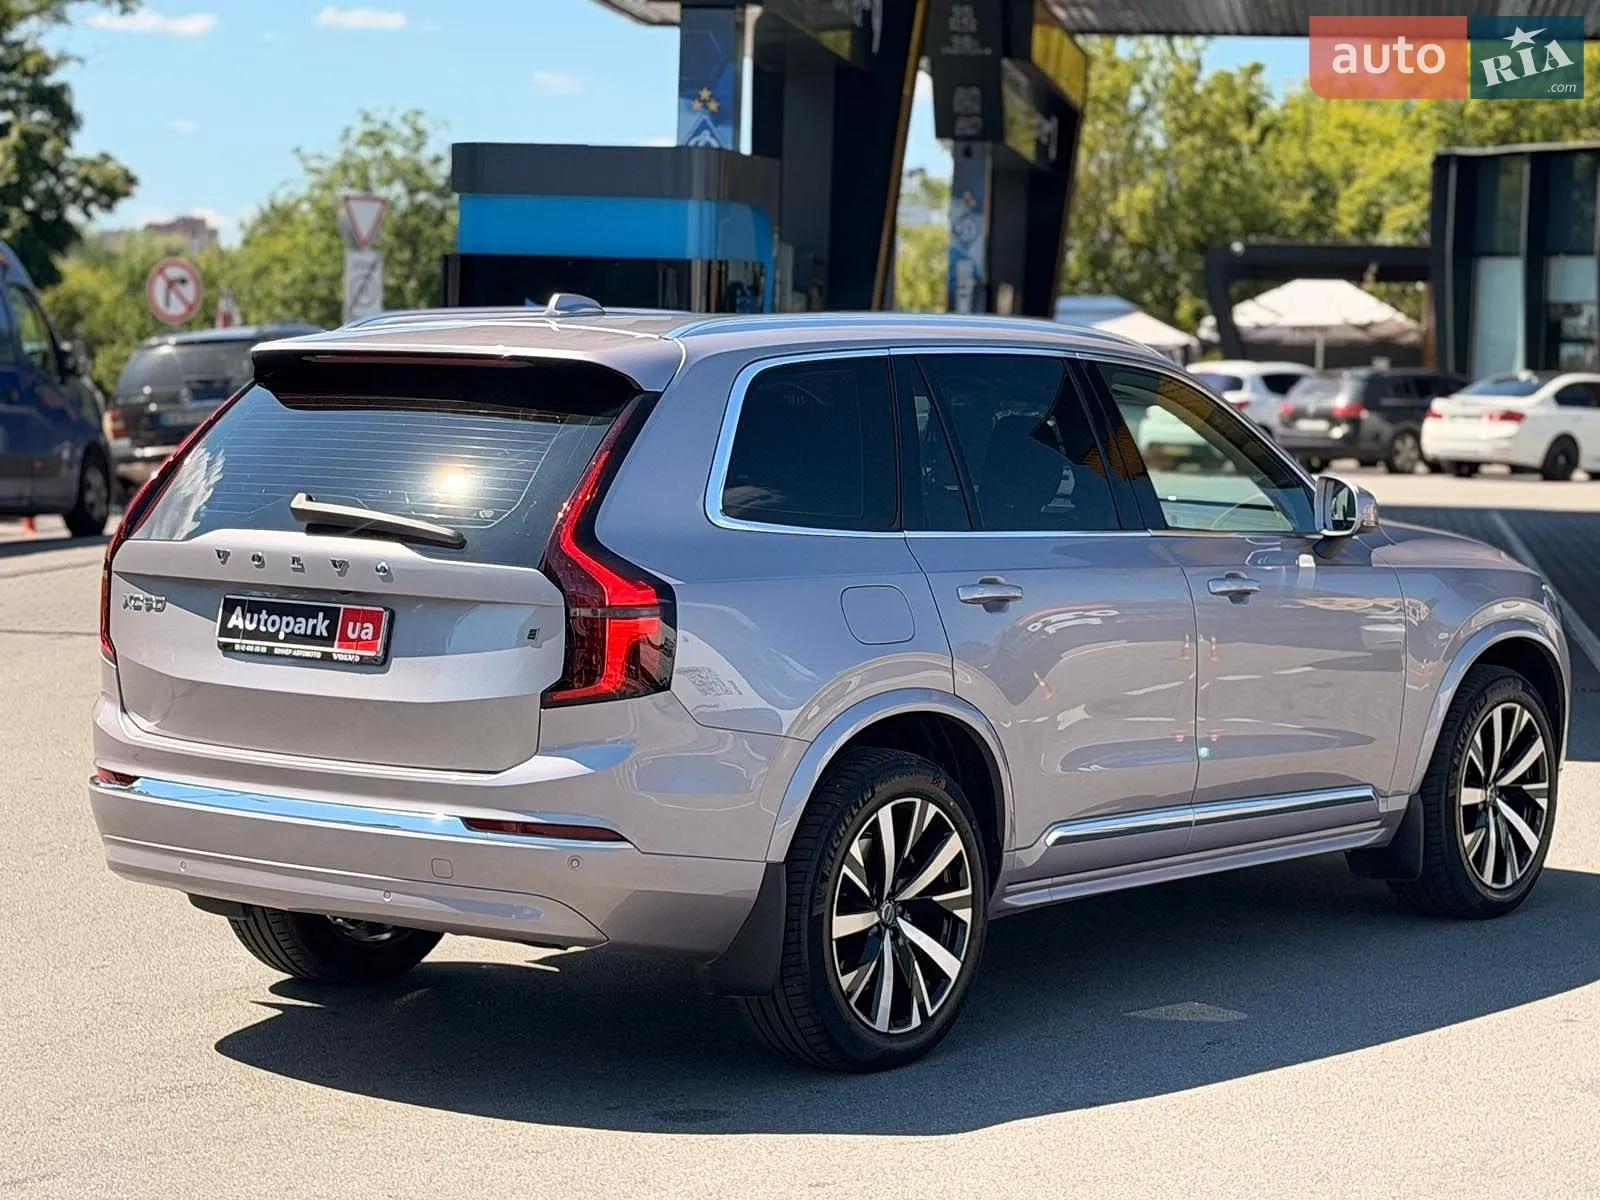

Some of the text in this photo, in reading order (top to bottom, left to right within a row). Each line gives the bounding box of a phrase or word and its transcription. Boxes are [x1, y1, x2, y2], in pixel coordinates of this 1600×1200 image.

[214, 549, 391, 578] VOLVO
[227, 606, 374, 640] Autopark ua
